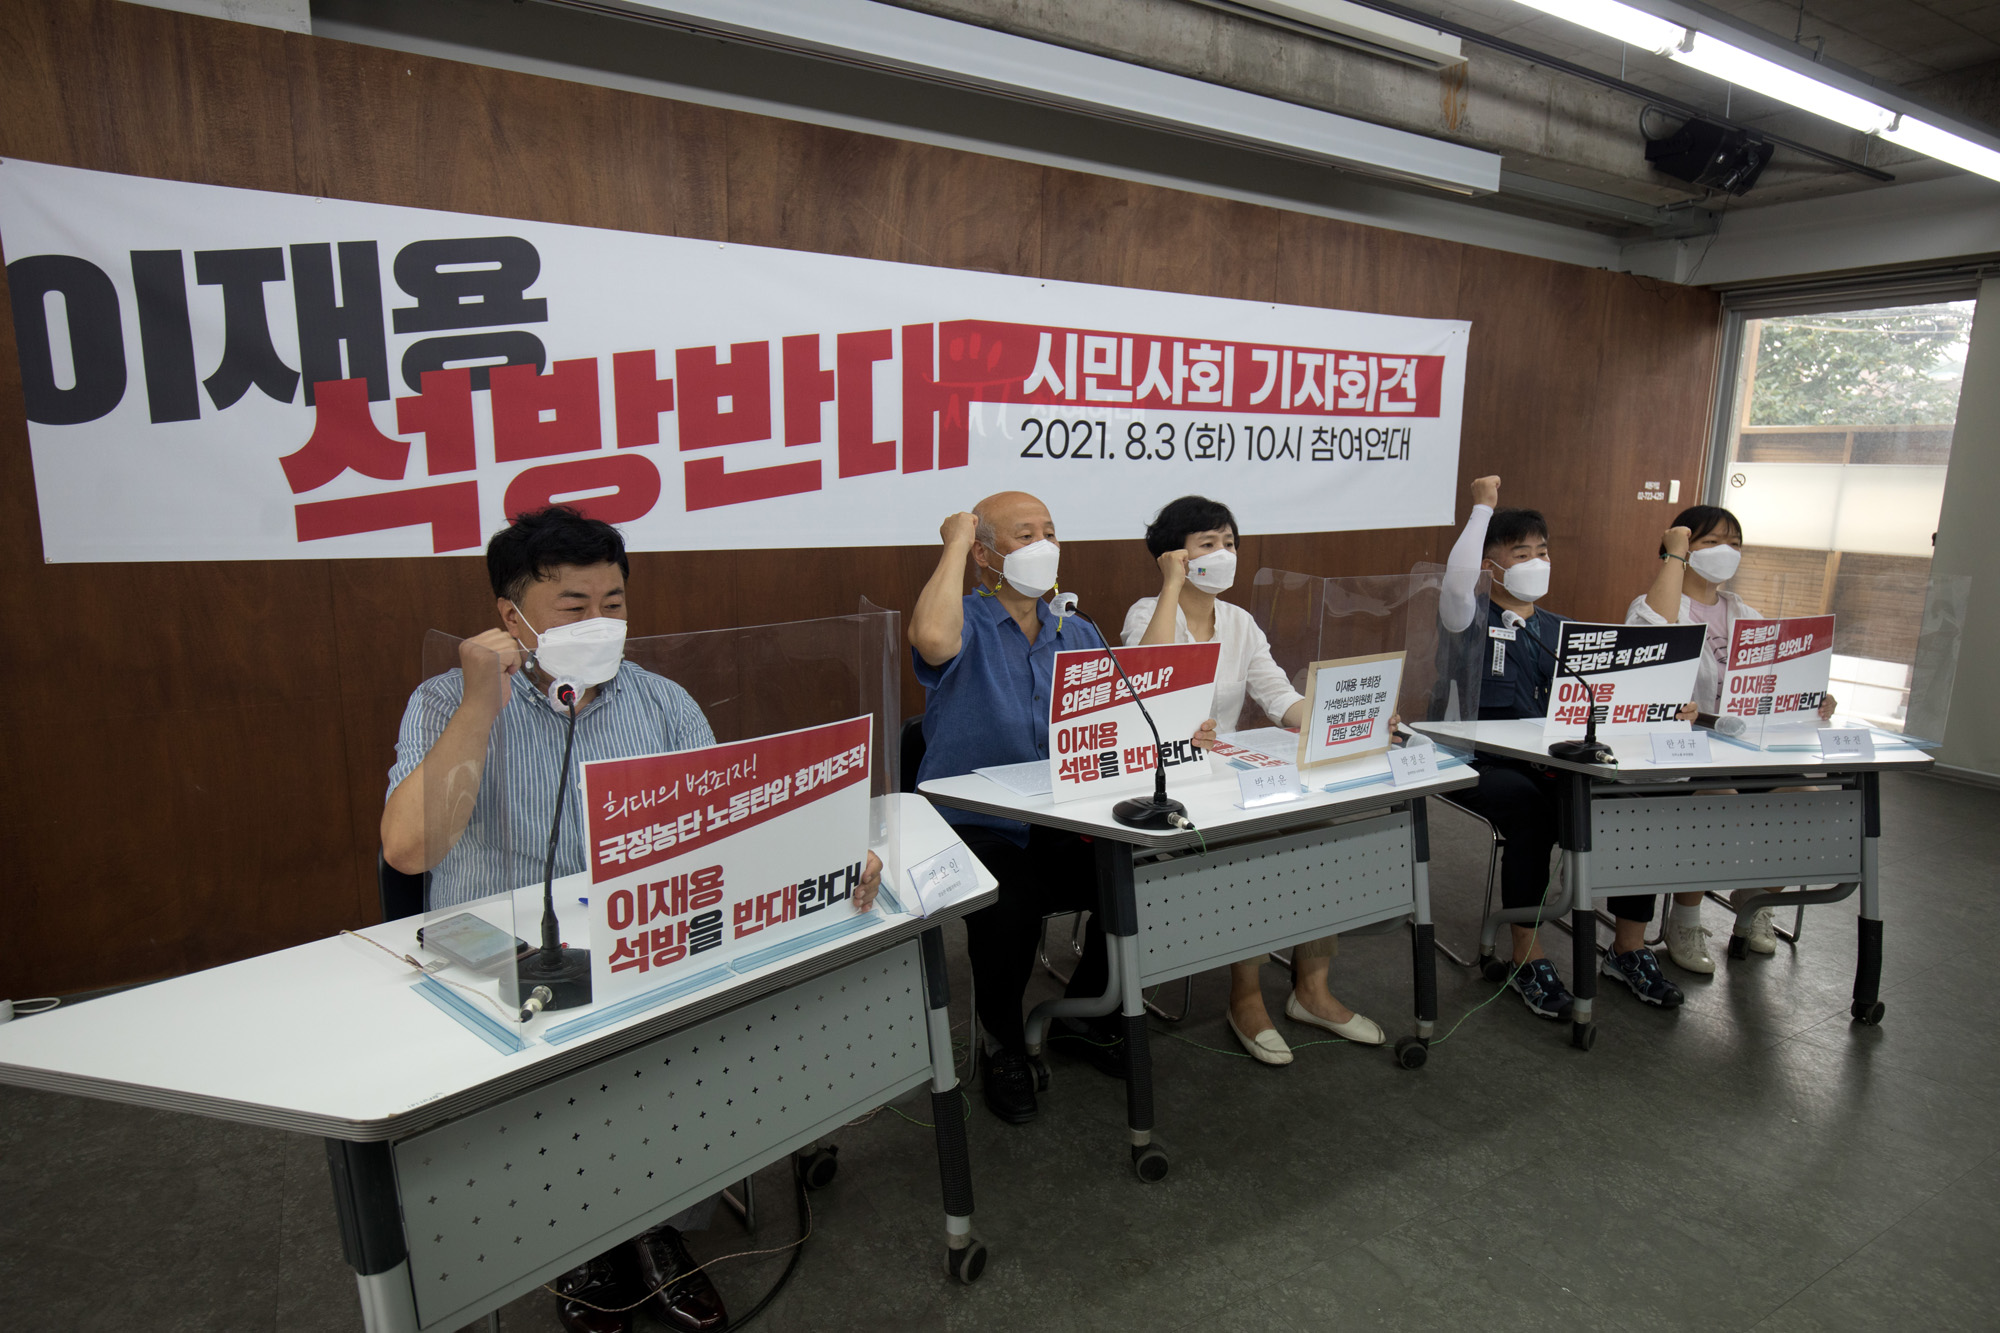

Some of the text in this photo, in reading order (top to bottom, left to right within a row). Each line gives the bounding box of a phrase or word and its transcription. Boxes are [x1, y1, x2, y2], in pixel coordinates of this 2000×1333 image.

[5, 235, 549, 427] 이재용
[1022, 332, 1419, 413] 시민사회 기자회견
[279, 318, 970, 554] 석방반대
[1020, 417, 1411, 462] 2021. 8.3 (화) 10시 참여연대
[1567, 630, 1619, 652] 국민은
[1735, 644, 1777, 666] 외침을
[1777, 633, 1814, 659] 잊었나?
[1739, 623, 1781, 647] 촛불의
[1063, 655, 1116, 689] 촛불의
[1564, 643, 1668, 674] 공감한 적 없다!
[1060, 666, 1174, 716] 외침을 잊었나?
[1335, 675, 1382, 693] 이재용 부회장
[1374, 691, 1387, 703] 관련
[1558, 682, 1616, 703] 이재용
[1729, 674, 1777, 695] 이재용
[1368, 706, 1380, 719] 장관
[1554, 704, 1609, 725] 석방을
[1727, 695, 1773, 717] 석방을
[1057, 721, 1118, 755] 이재용
[1331, 722, 1371, 741] 면담 요청서
[1058, 750, 1120, 785] 석방을
[602, 752, 758, 822] 희대의 범죄자!
[599, 742, 867, 866] 국정농단 노동탄압 회계조작
[606, 863, 725, 931] 이재용
[608, 908, 723, 975] 석방을
